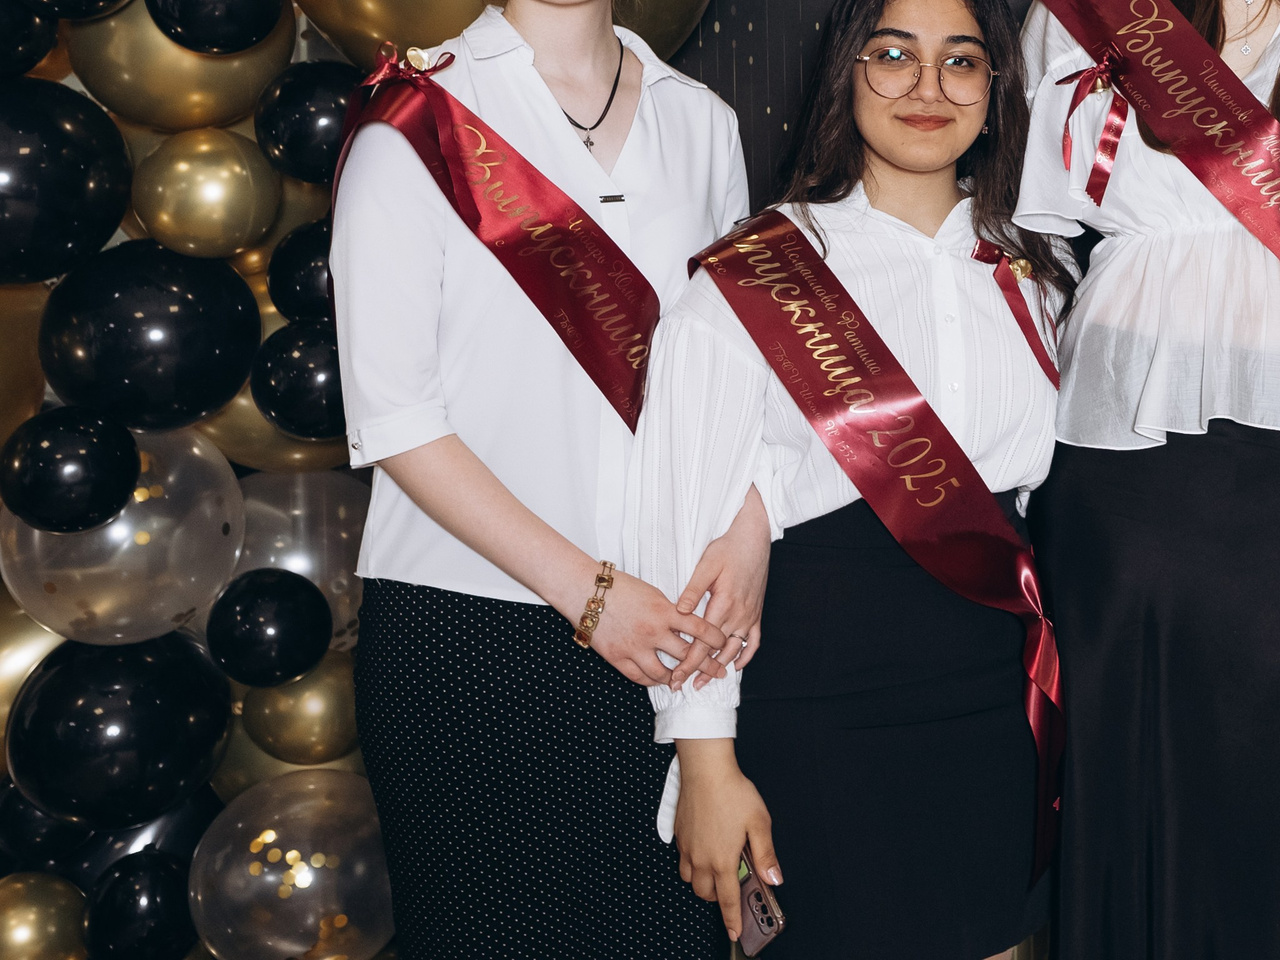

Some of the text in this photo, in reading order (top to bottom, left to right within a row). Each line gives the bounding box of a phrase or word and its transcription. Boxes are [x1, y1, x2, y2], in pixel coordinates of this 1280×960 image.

[1198, 59, 1254, 129] Пименова
[453, 123, 648, 370] Выпускница
[780, 233, 882, 377] Исмаилова Фатима
[722, 227, 961, 508] ыпускница 2025
[769, 340, 803, 385] ГБОУ
[798, 382, 824, 422] Школа
[836, 439, 858, 464] 1552
